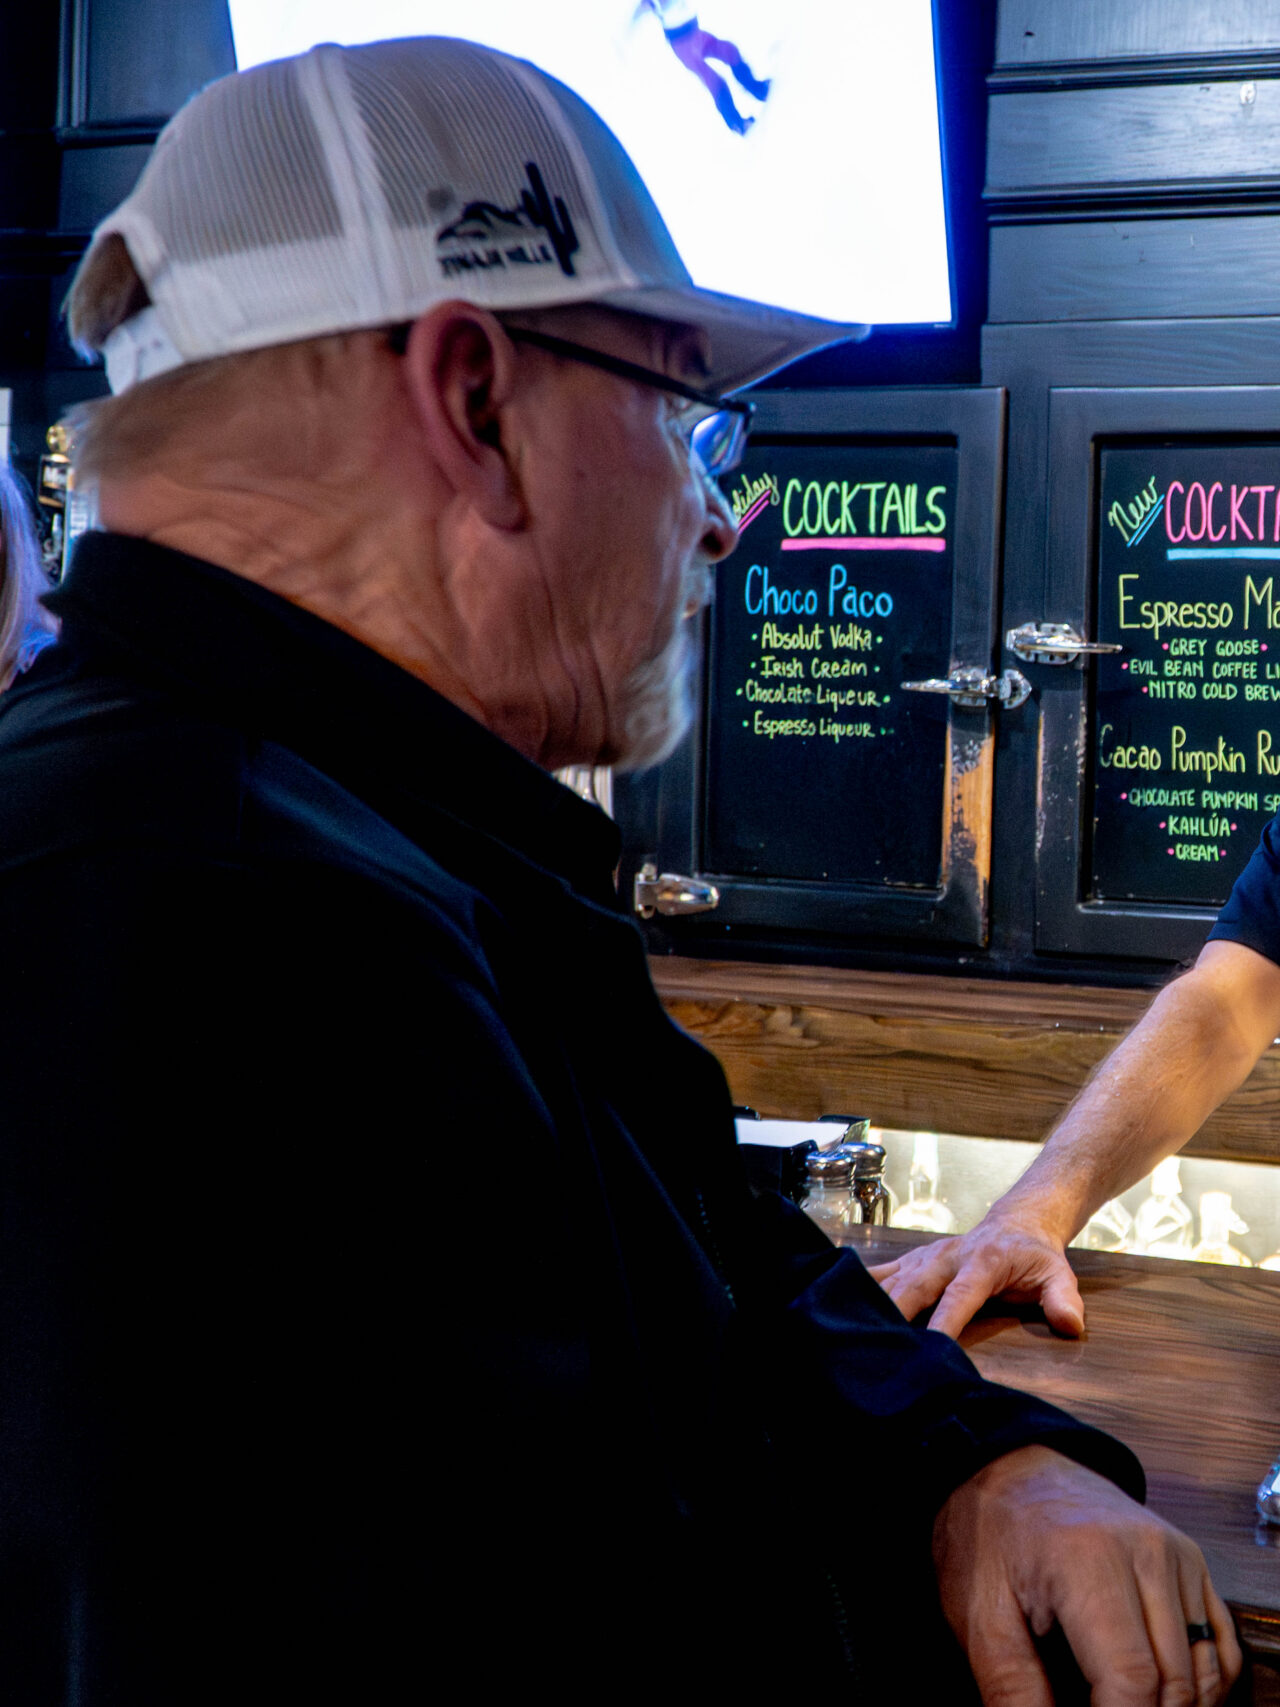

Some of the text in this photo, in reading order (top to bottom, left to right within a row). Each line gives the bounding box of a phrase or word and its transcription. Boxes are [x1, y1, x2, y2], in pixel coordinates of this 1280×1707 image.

[732, 471, 947, 537] oliday COCKTAILS
[1108, 475, 1157, 541] New
[745, 564, 893, 617] Choco Paco
[1119, 573, 1233, 640] Espresso
[761, 621, 824, 650] Absolut
[1169, 638, 1259, 656] GREY GOOSE
[1129, 659, 1158, 675] EVIL
[1164, 660, 1204, 678] BEAN
[1149, 680, 1197, 700] NITRO
[1202, 682, 1238, 700] COLD
[753, 709, 817, 740] Espresso
[1100, 724, 1162, 771] Cacao
[1171, 725, 1246, 784] Pumpkin
[1128, 788, 1196, 807] CHOCOLATE
[1201, 789, 1258, 811] PUMPKIN
[1168, 812, 1231, 837] KAHLÚA
[1175, 843, 1220, 862] CREAM
